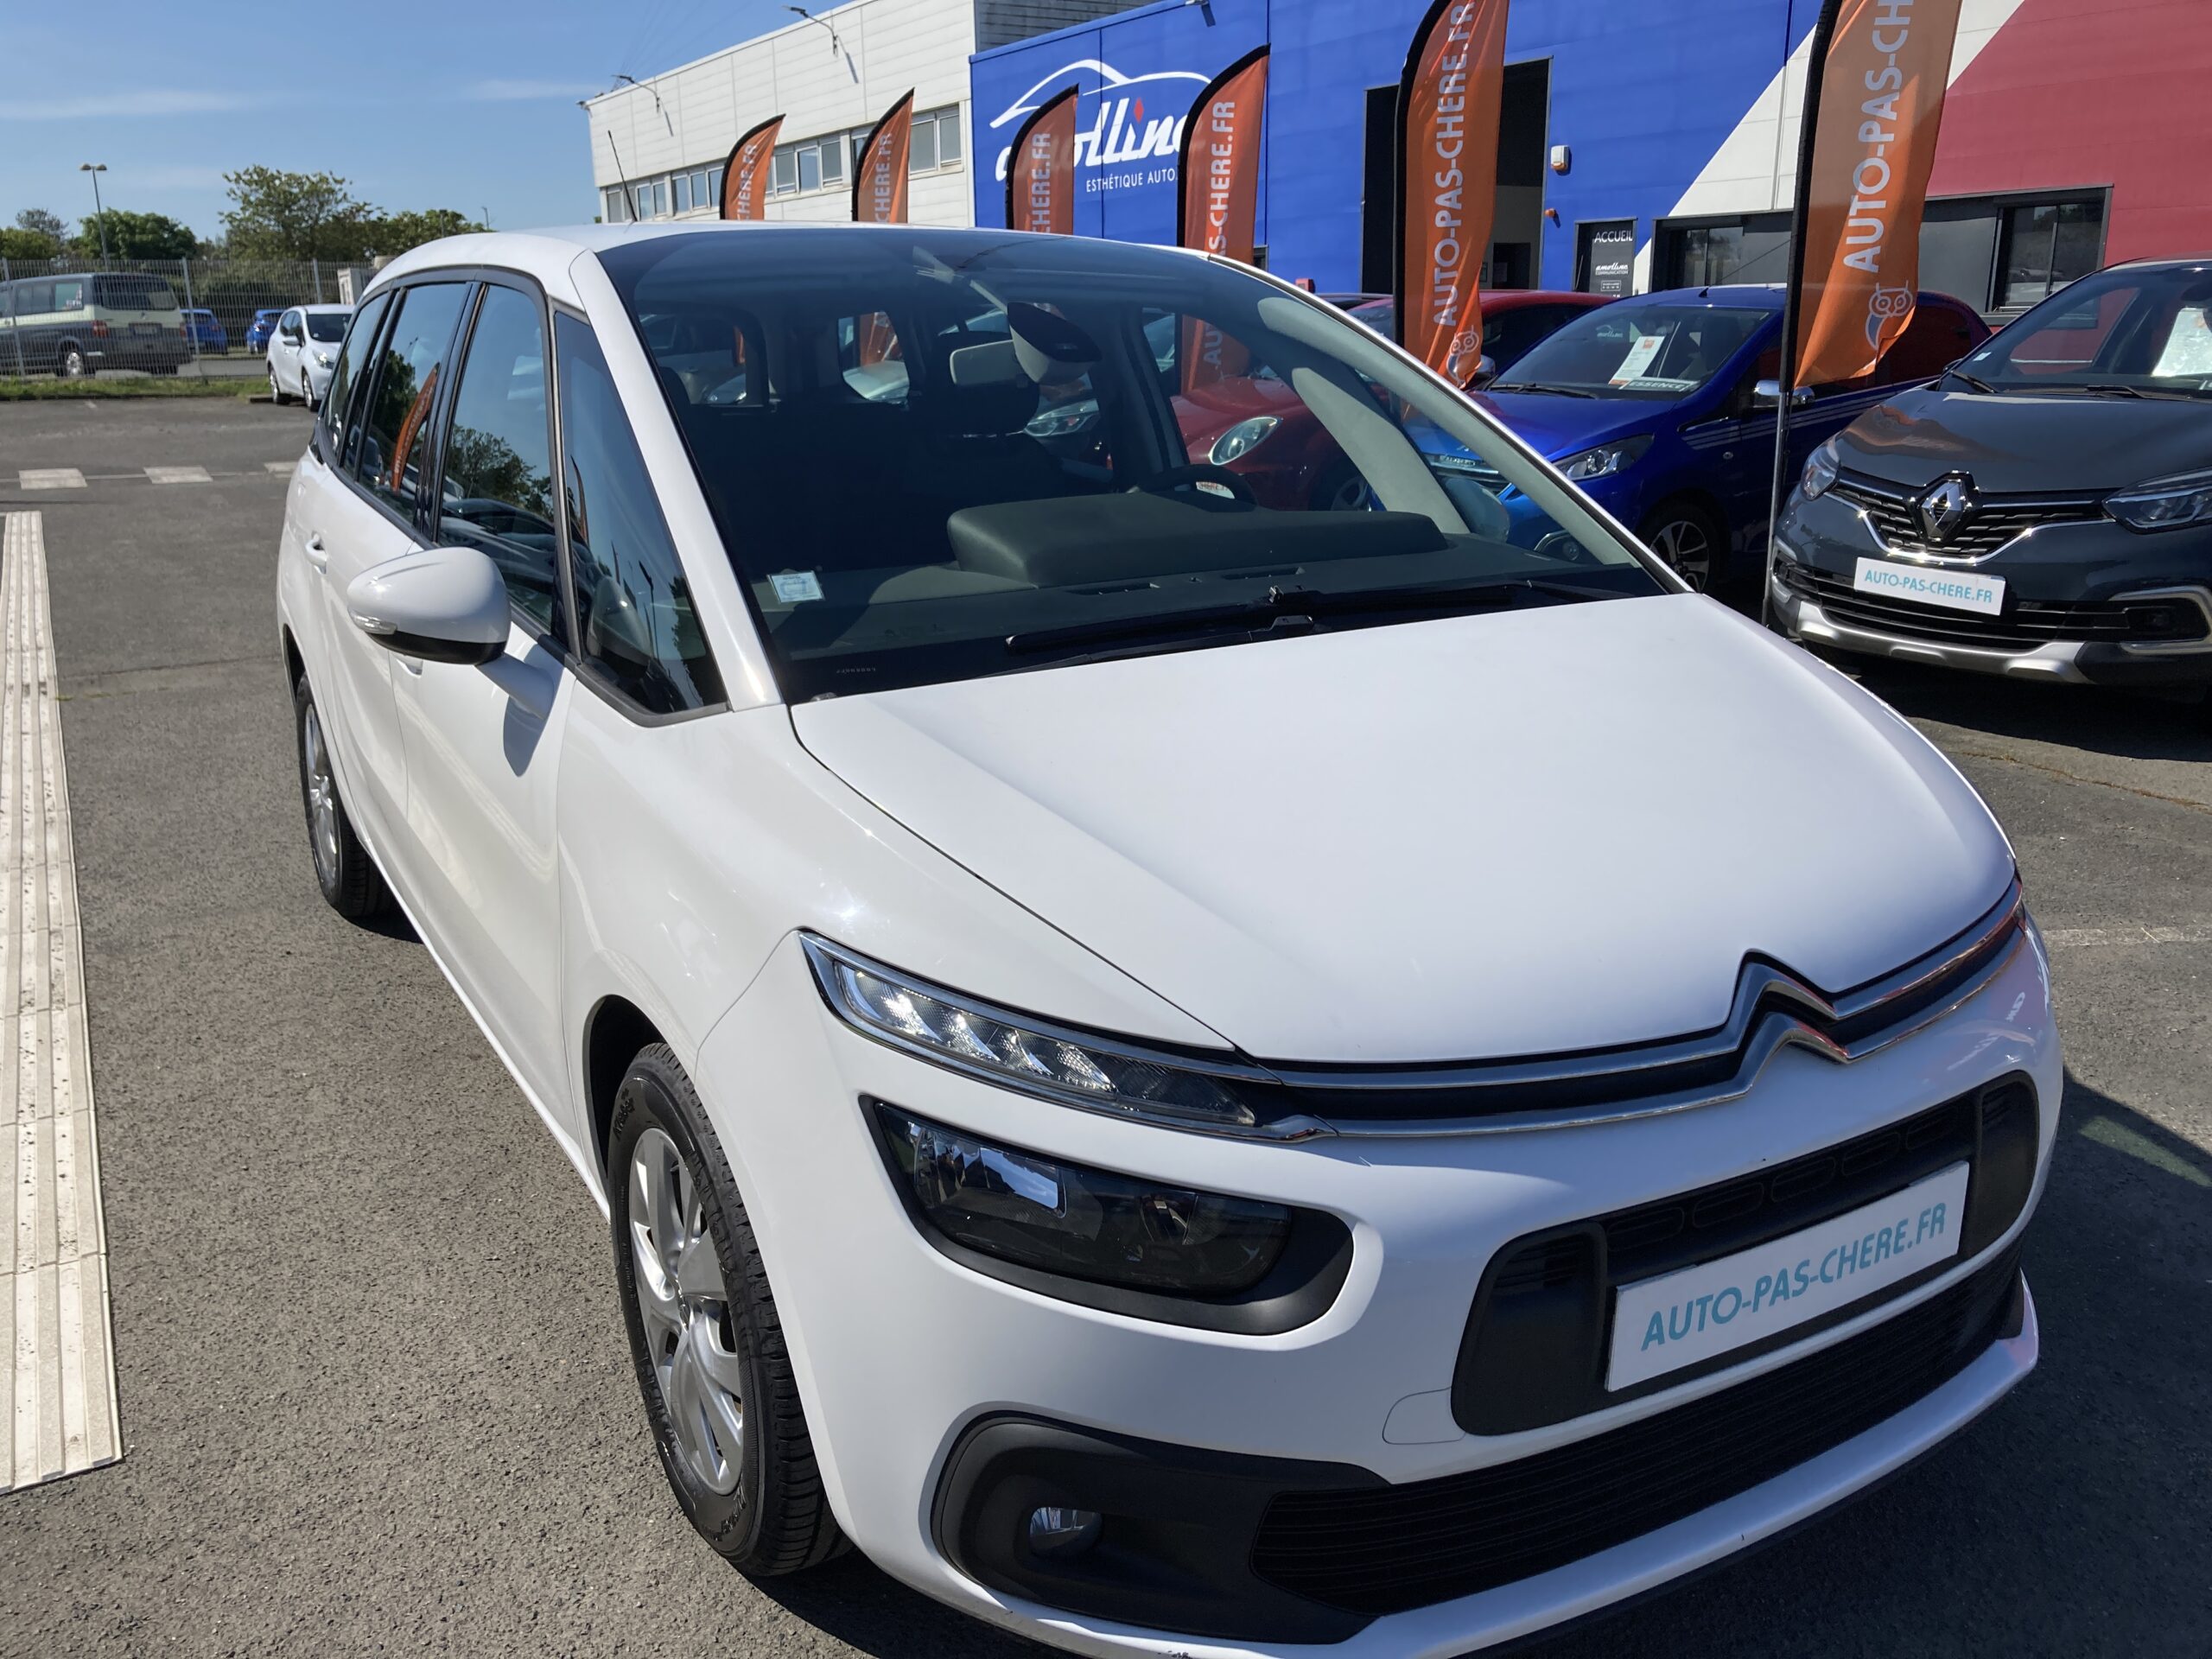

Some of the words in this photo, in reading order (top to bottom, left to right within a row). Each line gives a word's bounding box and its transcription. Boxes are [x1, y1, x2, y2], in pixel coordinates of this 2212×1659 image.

[1432, 2, 1475, 327] AUTO-PAS-CHERE.FR
[1085, 172, 1144, 193] ESTHÉTIQUE
[1594, 230, 1633, 243] ACCUEIL
[1628, 380, 1687, 390] ESSENCE
[1864, 569, 1993, 603] AUTO-PAS-CHERE.FR
[1640, 1201, 1948, 1352] AUTO-PAS-CHERE.FR
